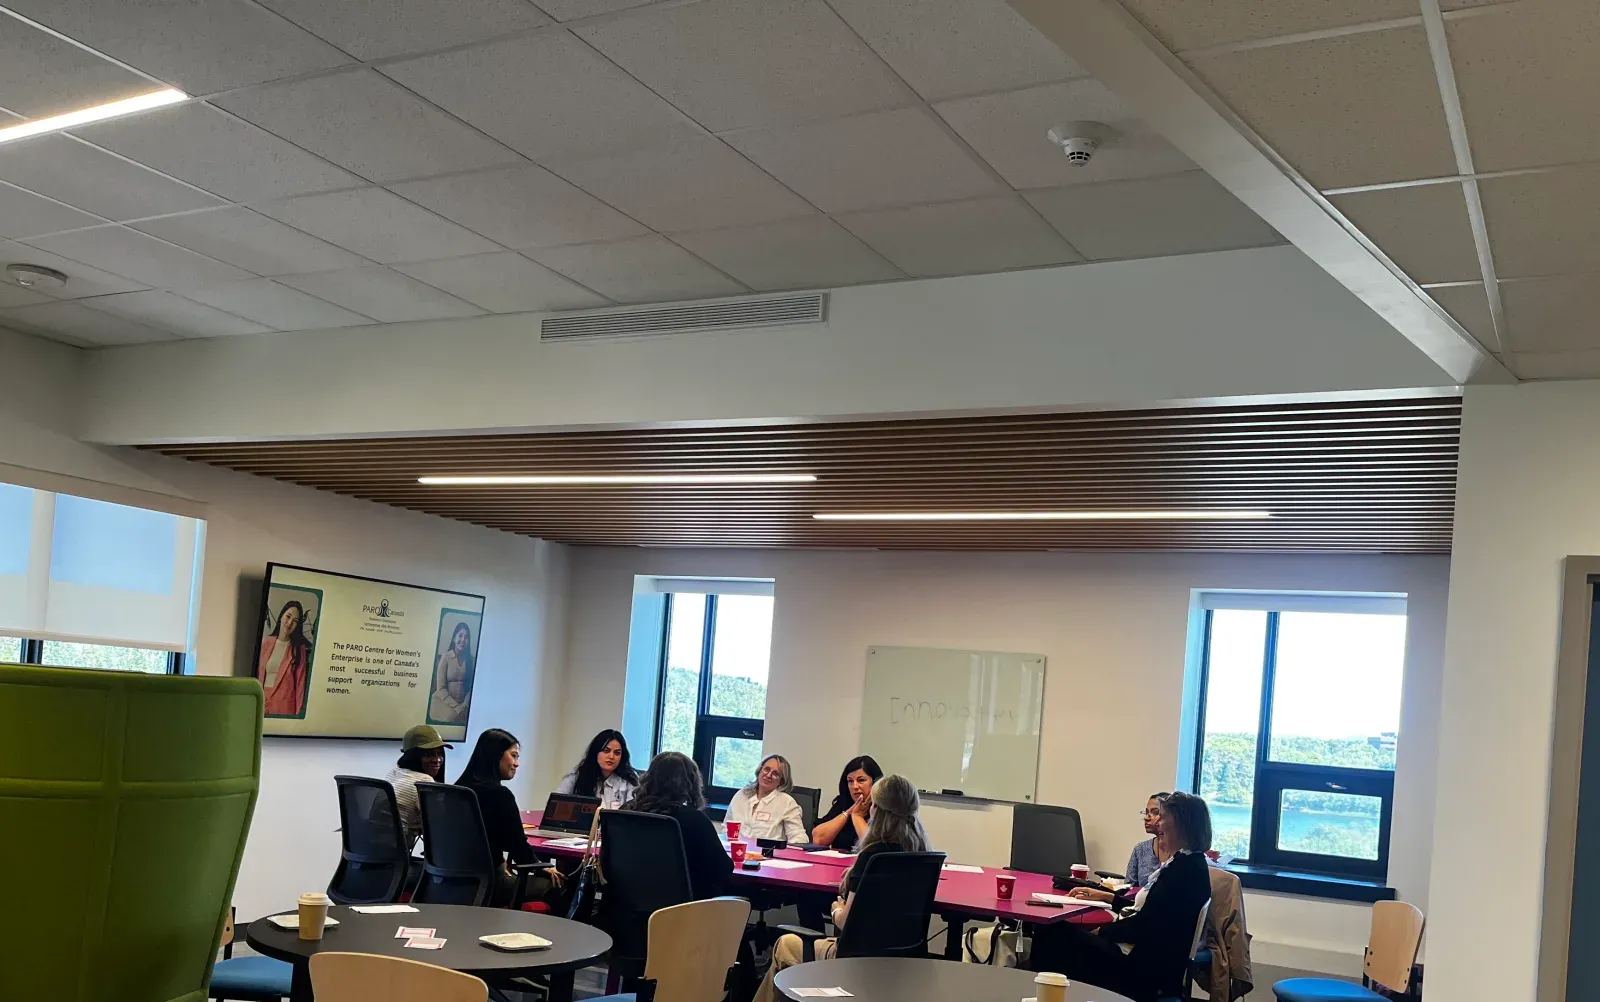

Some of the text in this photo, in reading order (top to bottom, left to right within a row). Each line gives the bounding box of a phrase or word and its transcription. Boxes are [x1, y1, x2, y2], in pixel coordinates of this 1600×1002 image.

[362, 604, 381, 616] PARO
[333, 642, 421, 657] The PARO Centre for Women's
[331, 653, 363, 663] Enterprise
[394, 659, 420, 668] Canada's
[354, 667, 386, 676] successful
[393, 670, 418, 678] business
[327, 676, 353, 685] support
[360, 678, 400, 688] organizations
